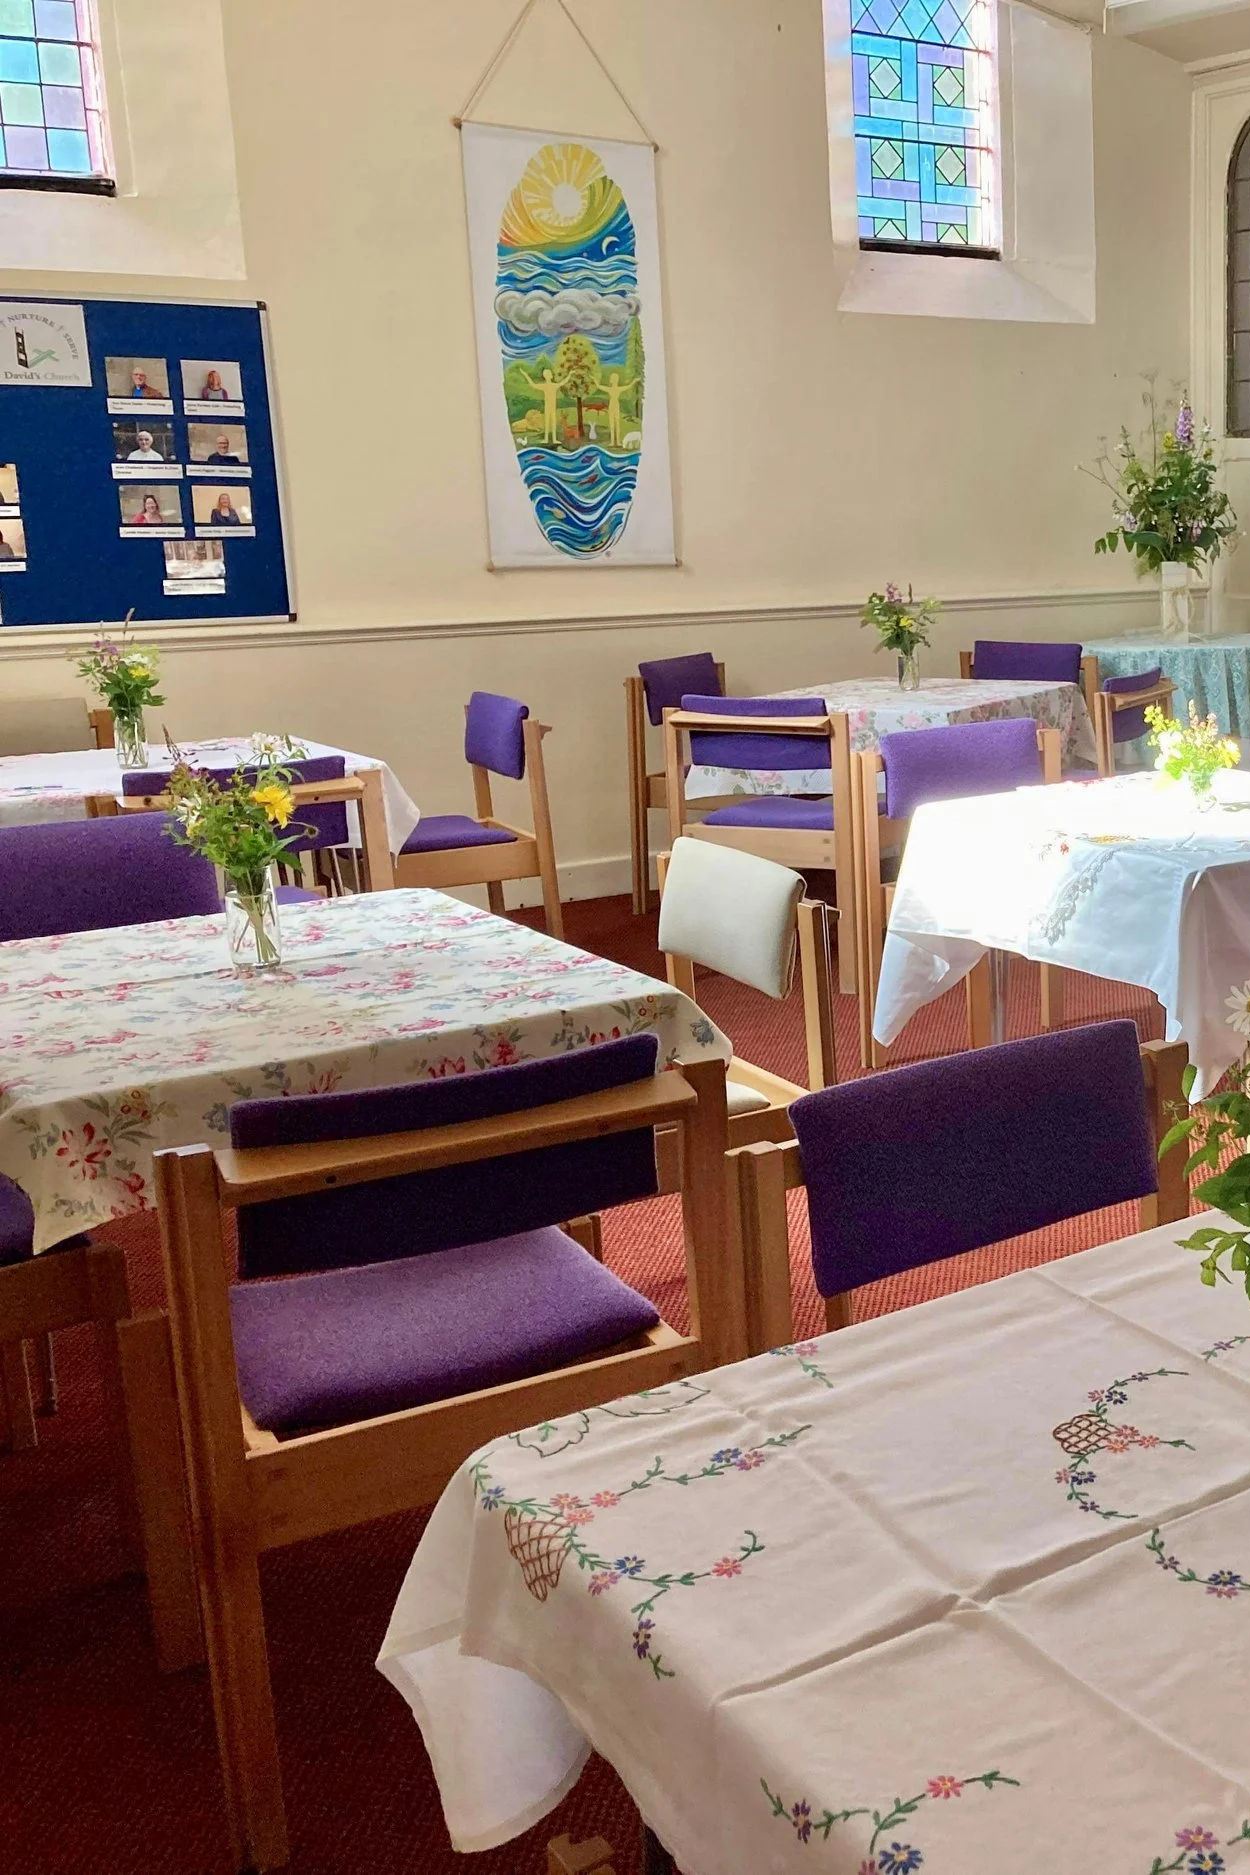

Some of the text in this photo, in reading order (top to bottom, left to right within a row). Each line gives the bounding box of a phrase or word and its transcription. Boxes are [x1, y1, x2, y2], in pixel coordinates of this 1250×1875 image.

[7, 313, 79, 360] NURTURE SERVE
[4, 371, 80, 381] David's Church
